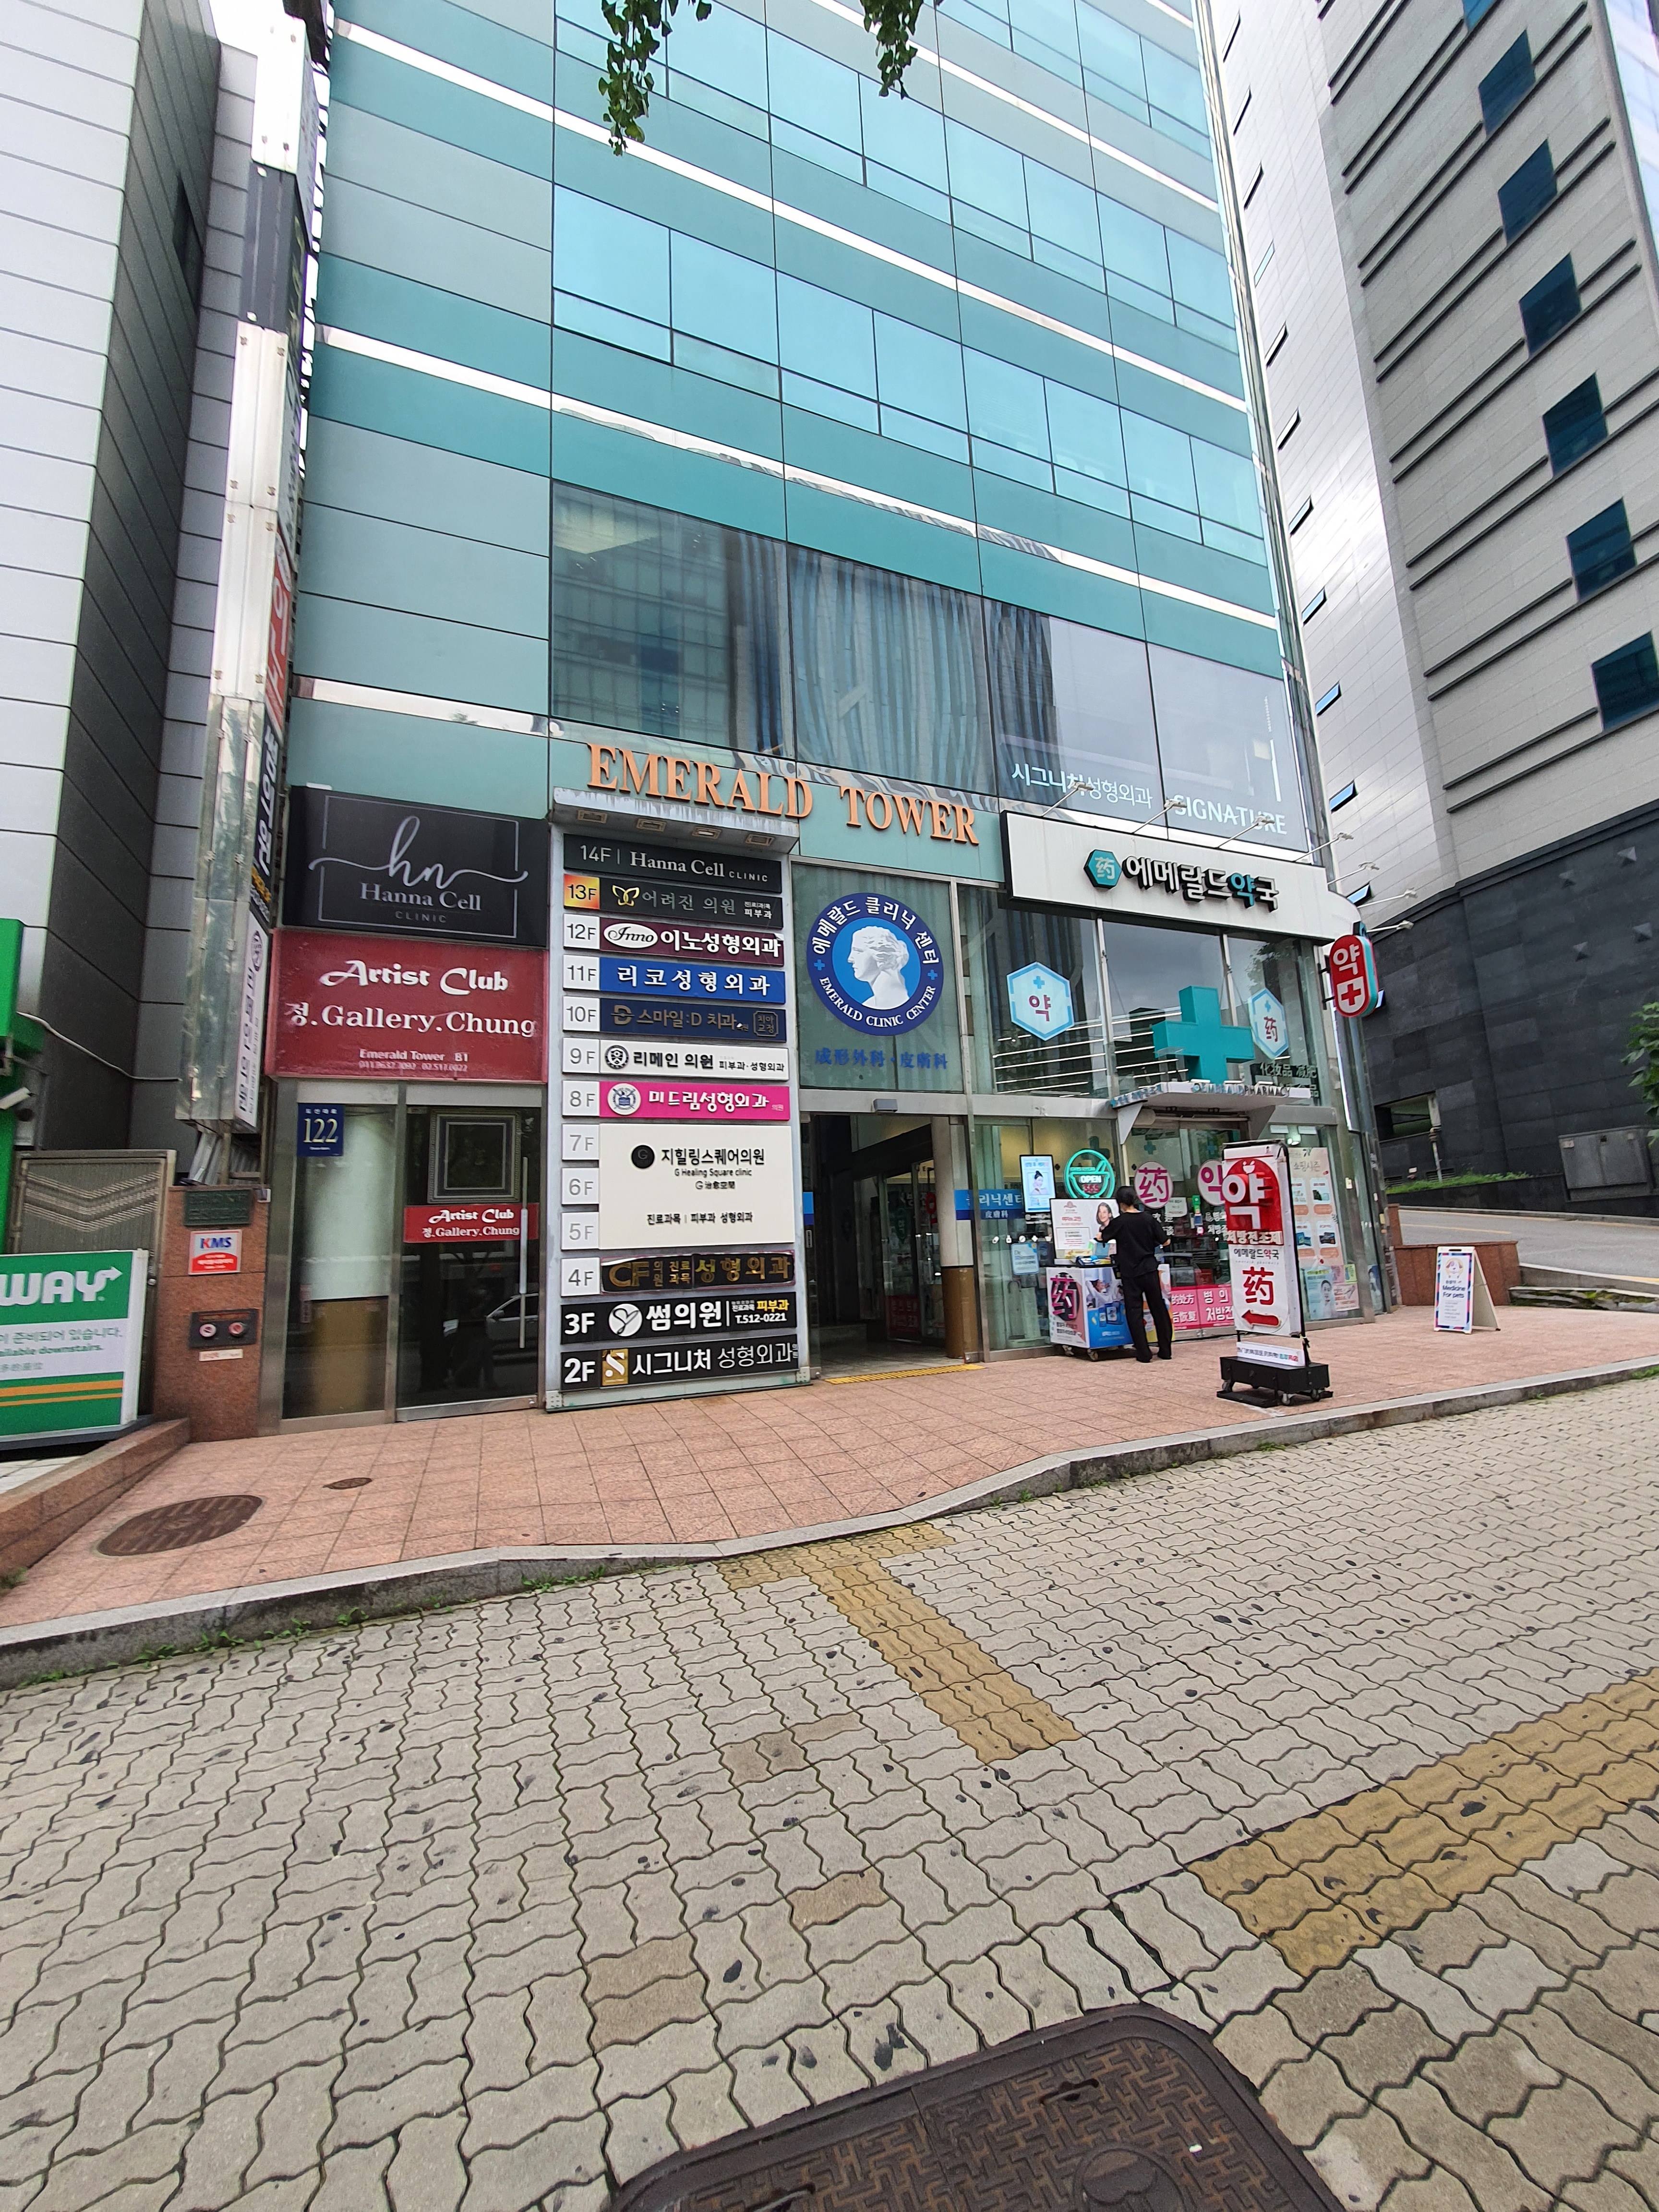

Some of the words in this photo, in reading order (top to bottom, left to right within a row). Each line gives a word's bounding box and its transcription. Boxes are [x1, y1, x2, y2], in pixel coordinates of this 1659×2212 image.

[587, 743, 813, 818] EMERALD
[840, 785, 979, 844] TOWER
[580, 844, 611, 863] 14F
[630, 852, 686, 873] Hanna
[691, 860, 725, 877] Cell
[729, 871, 769, 882] CLINIC
[1095, 858, 1115, 879] 药
[566, 884, 596, 901] 13F
[1122, 855, 1278, 912] 에메랄드약국
[361, 882, 433, 906] Hanna
[440, 891, 481, 911] Cell
[641, 891, 694, 912] 어려진
[703, 897, 735, 916] 의원
[396, 911, 447, 924] CLINIC
[744, 909, 772, 919] 피부과
[566, 925, 596, 940] 12F
[607, 926, 655, 943] Inno
[812, 901, 860, 954] 에메랄드
[866, 897, 916, 930] 클리닉
[916, 931, 939, 964] 센터
[661, 930, 781, 957] 이노성형외과
[1333, 945, 1359, 974] 약
[319, 960, 430, 987] Artist
[440, 968, 509, 995] Club
[566, 966, 596, 982] 11F
[819, 977, 863, 1021] EMERALD
[866, 1015, 903, 1027] CLINIC
[907, 986, 936, 1020] CENTER
[1029, 995, 1051, 1022] 약
[565, 1007, 596, 1022] 10F
[707, 1012, 737, 1031] 치과
[758, 1025, 774, 1033] 교정
[1263, 1017, 1278, 1042] 药
[360, 1048, 408, 1060] Emerald
[410, 1050, 445, 1061] Tower
[455, 1053, 469, 1062] B1
[569, 1048, 595, 1064] 9F
[633, 1051, 679, 1068] 리메인
[684, 1054, 714, 1069] 의원
[570, 1091, 595, 1107] 8F
[648, 1091, 769, 1113] 미드림성형외과
[303, 1118, 338, 1143] 122
[569, 1135, 594, 1151] 7F
[661, 1148, 764, 1166] 지힐링스퀘어의원
[682, 1168, 707, 1178] Healing
[709, 1168, 733, 1178] Square
[1079, 1175, 1102, 1183] OPEN
[568, 1179, 594, 1196] 6F
[1082, 1184, 1100, 1193] 365
[1138, 1167, 1169, 1203] 药
[1222, 1173, 1273, 1229] 약
[429, 1209, 479, 1224] Artist
[481, 1209, 514, 1223] Club
[647, 1213, 681, 1225] 진료과목
[690, 1213, 716, 1224] 피부과
[720, 1212, 753, 1223] 성형외과
[568, 1224, 594, 1240] 5F
[200, 1237, 232, 1249] KMS
[1234, 1249, 1279, 1260] 에메랄드약국
[568, 1269, 594, 1286] 4F
[609, 1262, 649, 1287] CF
[1243, 1266, 1274, 1305] 药
[757, 1299, 789, 1312] 피부과
[1050, 1274, 1077, 1319] 药
[565, 1312, 595, 1334] 3F
[646, 1301, 722, 1331] 썸의원
[734, 1313, 787, 1324] T.512-0221
[632, 1349, 711, 1375] 시그니처
[717, 1343, 791, 1368] 성형외과
[564, 1359, 595, 1382] 2F
